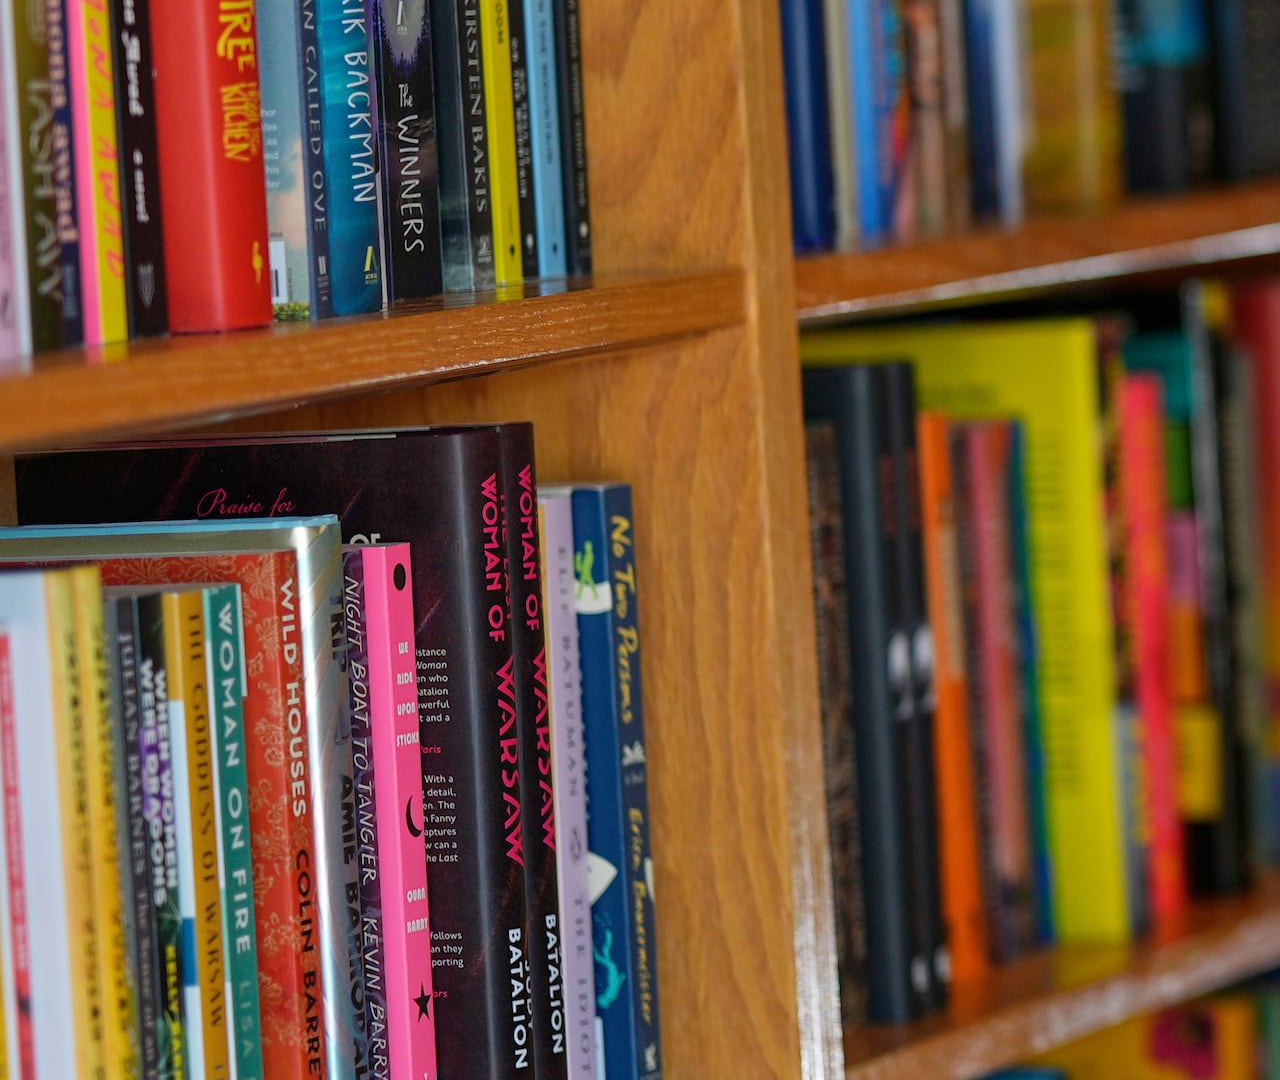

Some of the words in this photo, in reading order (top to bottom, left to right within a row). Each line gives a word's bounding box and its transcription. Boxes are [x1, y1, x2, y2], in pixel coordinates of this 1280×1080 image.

[120, 29, 145, 117] Awad
[304, 45, 323, 155] CALLED
[398, 83, 414, 109] The
[219, 83, 251, 163] KITCHEN
[343, 51, 377, 203] BACKMAN
[51, 123, 79, 244] awad
[96, 134, 125, 280] AWAD
[312, 170, 328, 231] OVE
[397, 113, 425, 254] WINNERS
[470, 124, 488, 214] BAKIS
[196, 487, 264, 517] Praise
[269, 487, 297, 517] for
[480, 472, 502, 591] WOMAN
[517, 463, 536, 581] WOMAN
[611, 514, 632, 558] No
[279, 577, 297, 666] WILD
[344, 574, 363, 654] NIGHT
[487, 603, 505, 643] OF
[525, 592, 540, 632] OF
[614, 563, 637, 619] Two
[117, 631, 138, 741] JULIAN
[217, 602, 241, 768] WOMAN
[396, 671, 414, 686] RIDE
[397, 641, 410, 655] WE
[428, 673, 449, 683] who
[617, 625, 640, 724] Persons
[140, 656, 157, 746] WERE
[153, 668, 170, 762] WHEN
[350, 659, 370, 729] BOAT
[396, 700, 417, 717] UPON
[425, 713, 443, 723] and
[561, 635, 579, 798] BATUMAN
[285, 681, 308, 818] HOUSES
[351, 739, 370, 772] TO
[424, 773, 447, 784] With
[495, 654, 527, 868] WARSAW
[531, 644, 557, 852] WARSAW
[126, 754, 146, 875] BARNES
[144, 752, 168, 907] DRAGONS
[160, 769, 178, 888] WOMEN
[226, 786, 245, 850] ON
[339, 774, 357, 865] AMIE
[357, 779, 378, 887] TANGIER
[427, 787, 457, 798] detail,
[431, 813, 457, 826] Fanny
[438, 800, 456, 810] The
[433, 841, 450, 851] can
[438, 853, 459, 863] Last
[232, 868, 251, 955] FIRE
[295, 848, 316, 954] COLIN
[406, 887, 426, 904] QUAN
[406, 916, 429, 934] BARRY
[430, 931, 463, 941] follows
[204, 900, 223, 1028] WARSAW
[362, 915, 382, 991] KEVIN
[431, 956, 465, 969] porting
[442, 943, 464, 957] they
[544, 913, 564, 1055] BATALION
[507, 926, 529, 1070] BATALION
